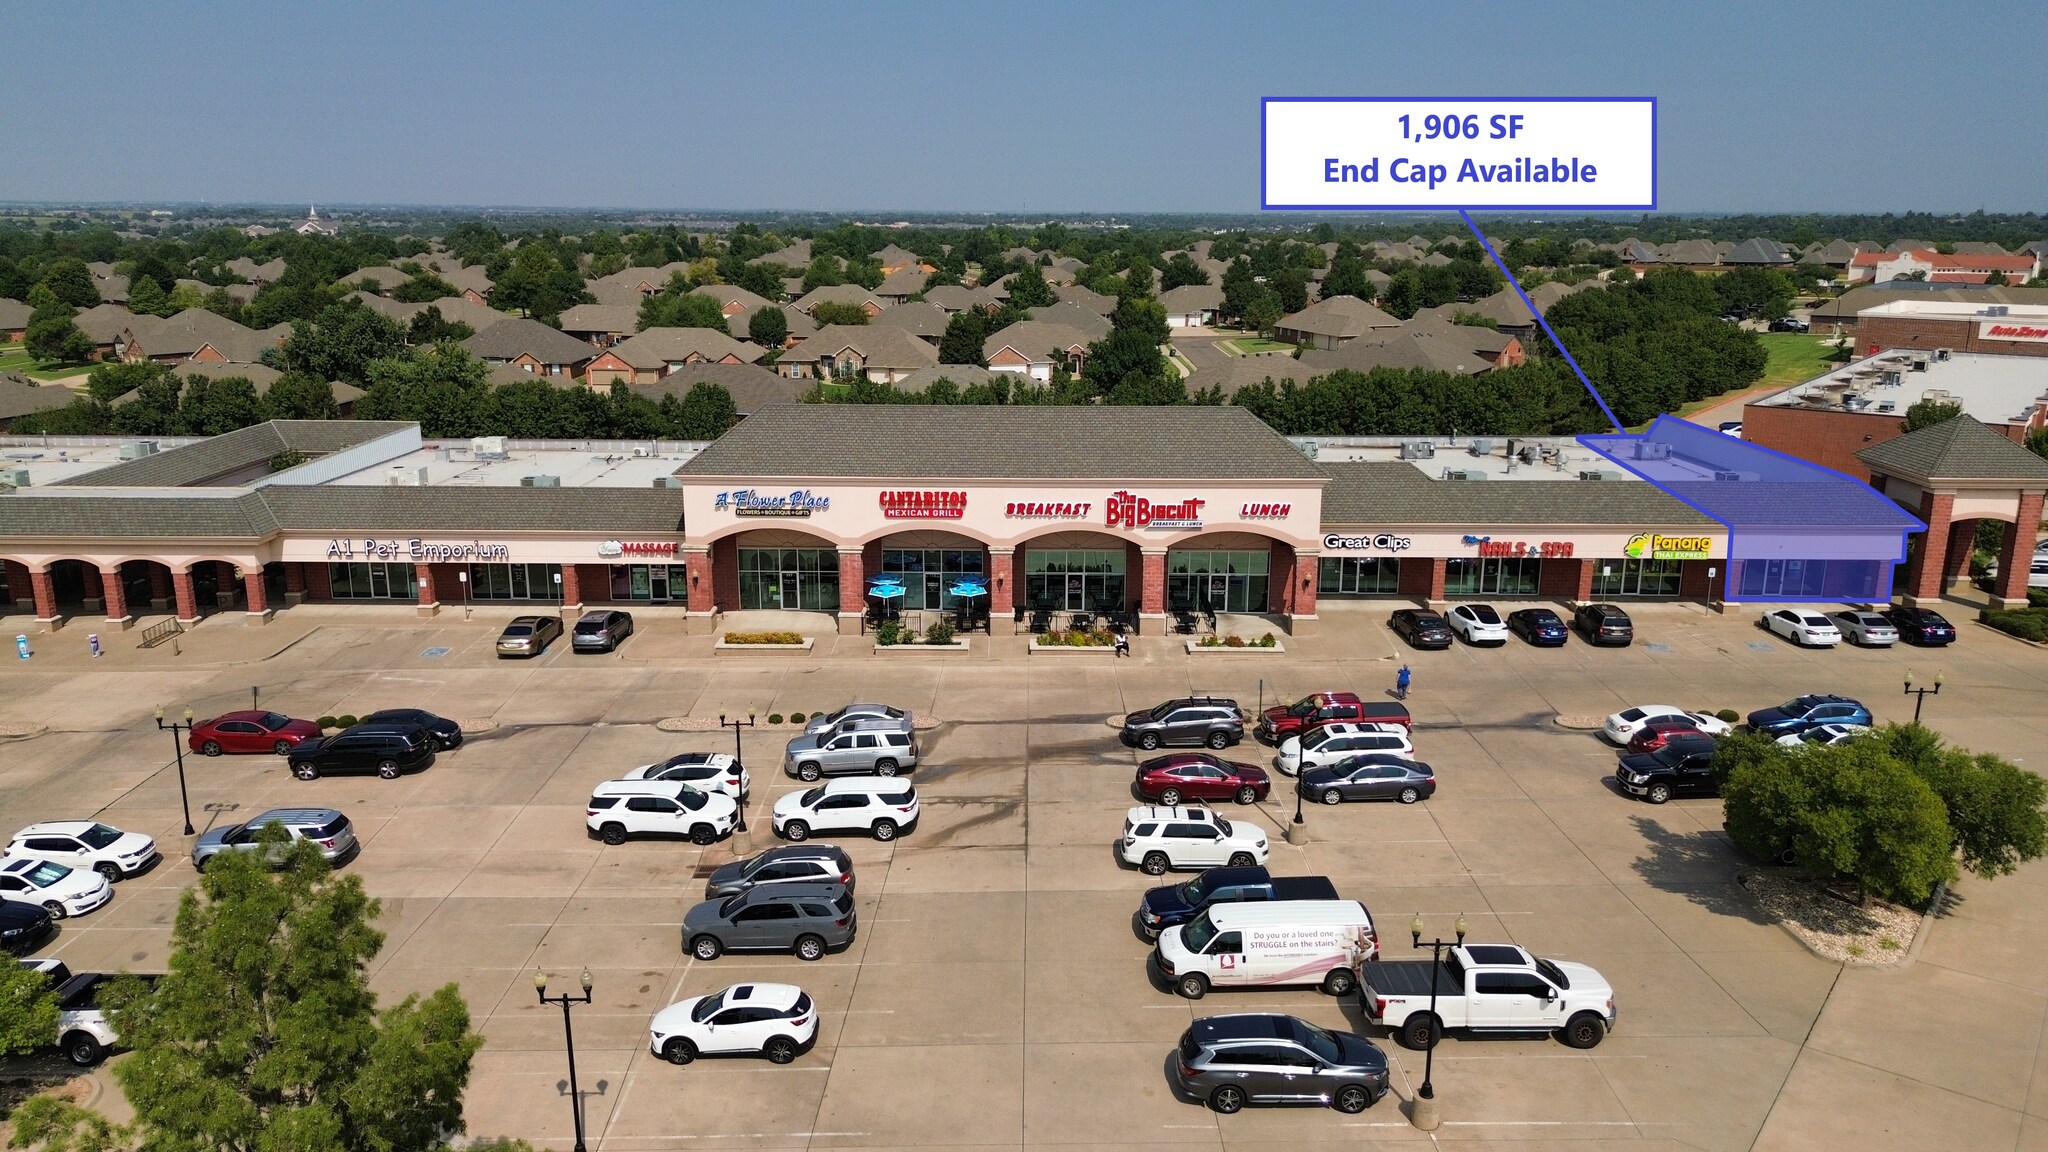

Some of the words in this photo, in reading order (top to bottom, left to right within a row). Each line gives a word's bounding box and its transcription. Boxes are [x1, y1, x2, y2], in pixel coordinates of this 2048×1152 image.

[715, 492, 728, 506] A
[733, 489, 786, 508] Flower
[789, 490, 830, 507] Place
[888, 509, 929, 517] MEXICAN
[932, 509, 960, 517] GRILL
[1006, 502, 1091, 516] BREAKFAST
[1241, 503, 1292, 516] LUNCH
[622, 542, 679, 554] MASSAGE
[1324, 534, 1370, 549] Great
[1373, 534, 1411, 552] Clips
[1480, 541, 1527, 557] NAILS
[1529, 546, 1537, 555] &
[1541, 541, 1574, 557] SPA
[1652, 534, 1712, 551] Panang
[327, 539, 352, 557] A1
[364, 539, 400, 557] Pet
[408, 538, 509, 562] Emporium
[1253, 932, 1264, 940] Do
[1297, 930, 1318, 938] loved
[1250, 941, 1287, 949] STRUGGLE
[1314, 939, 1338, 947] stairs?
